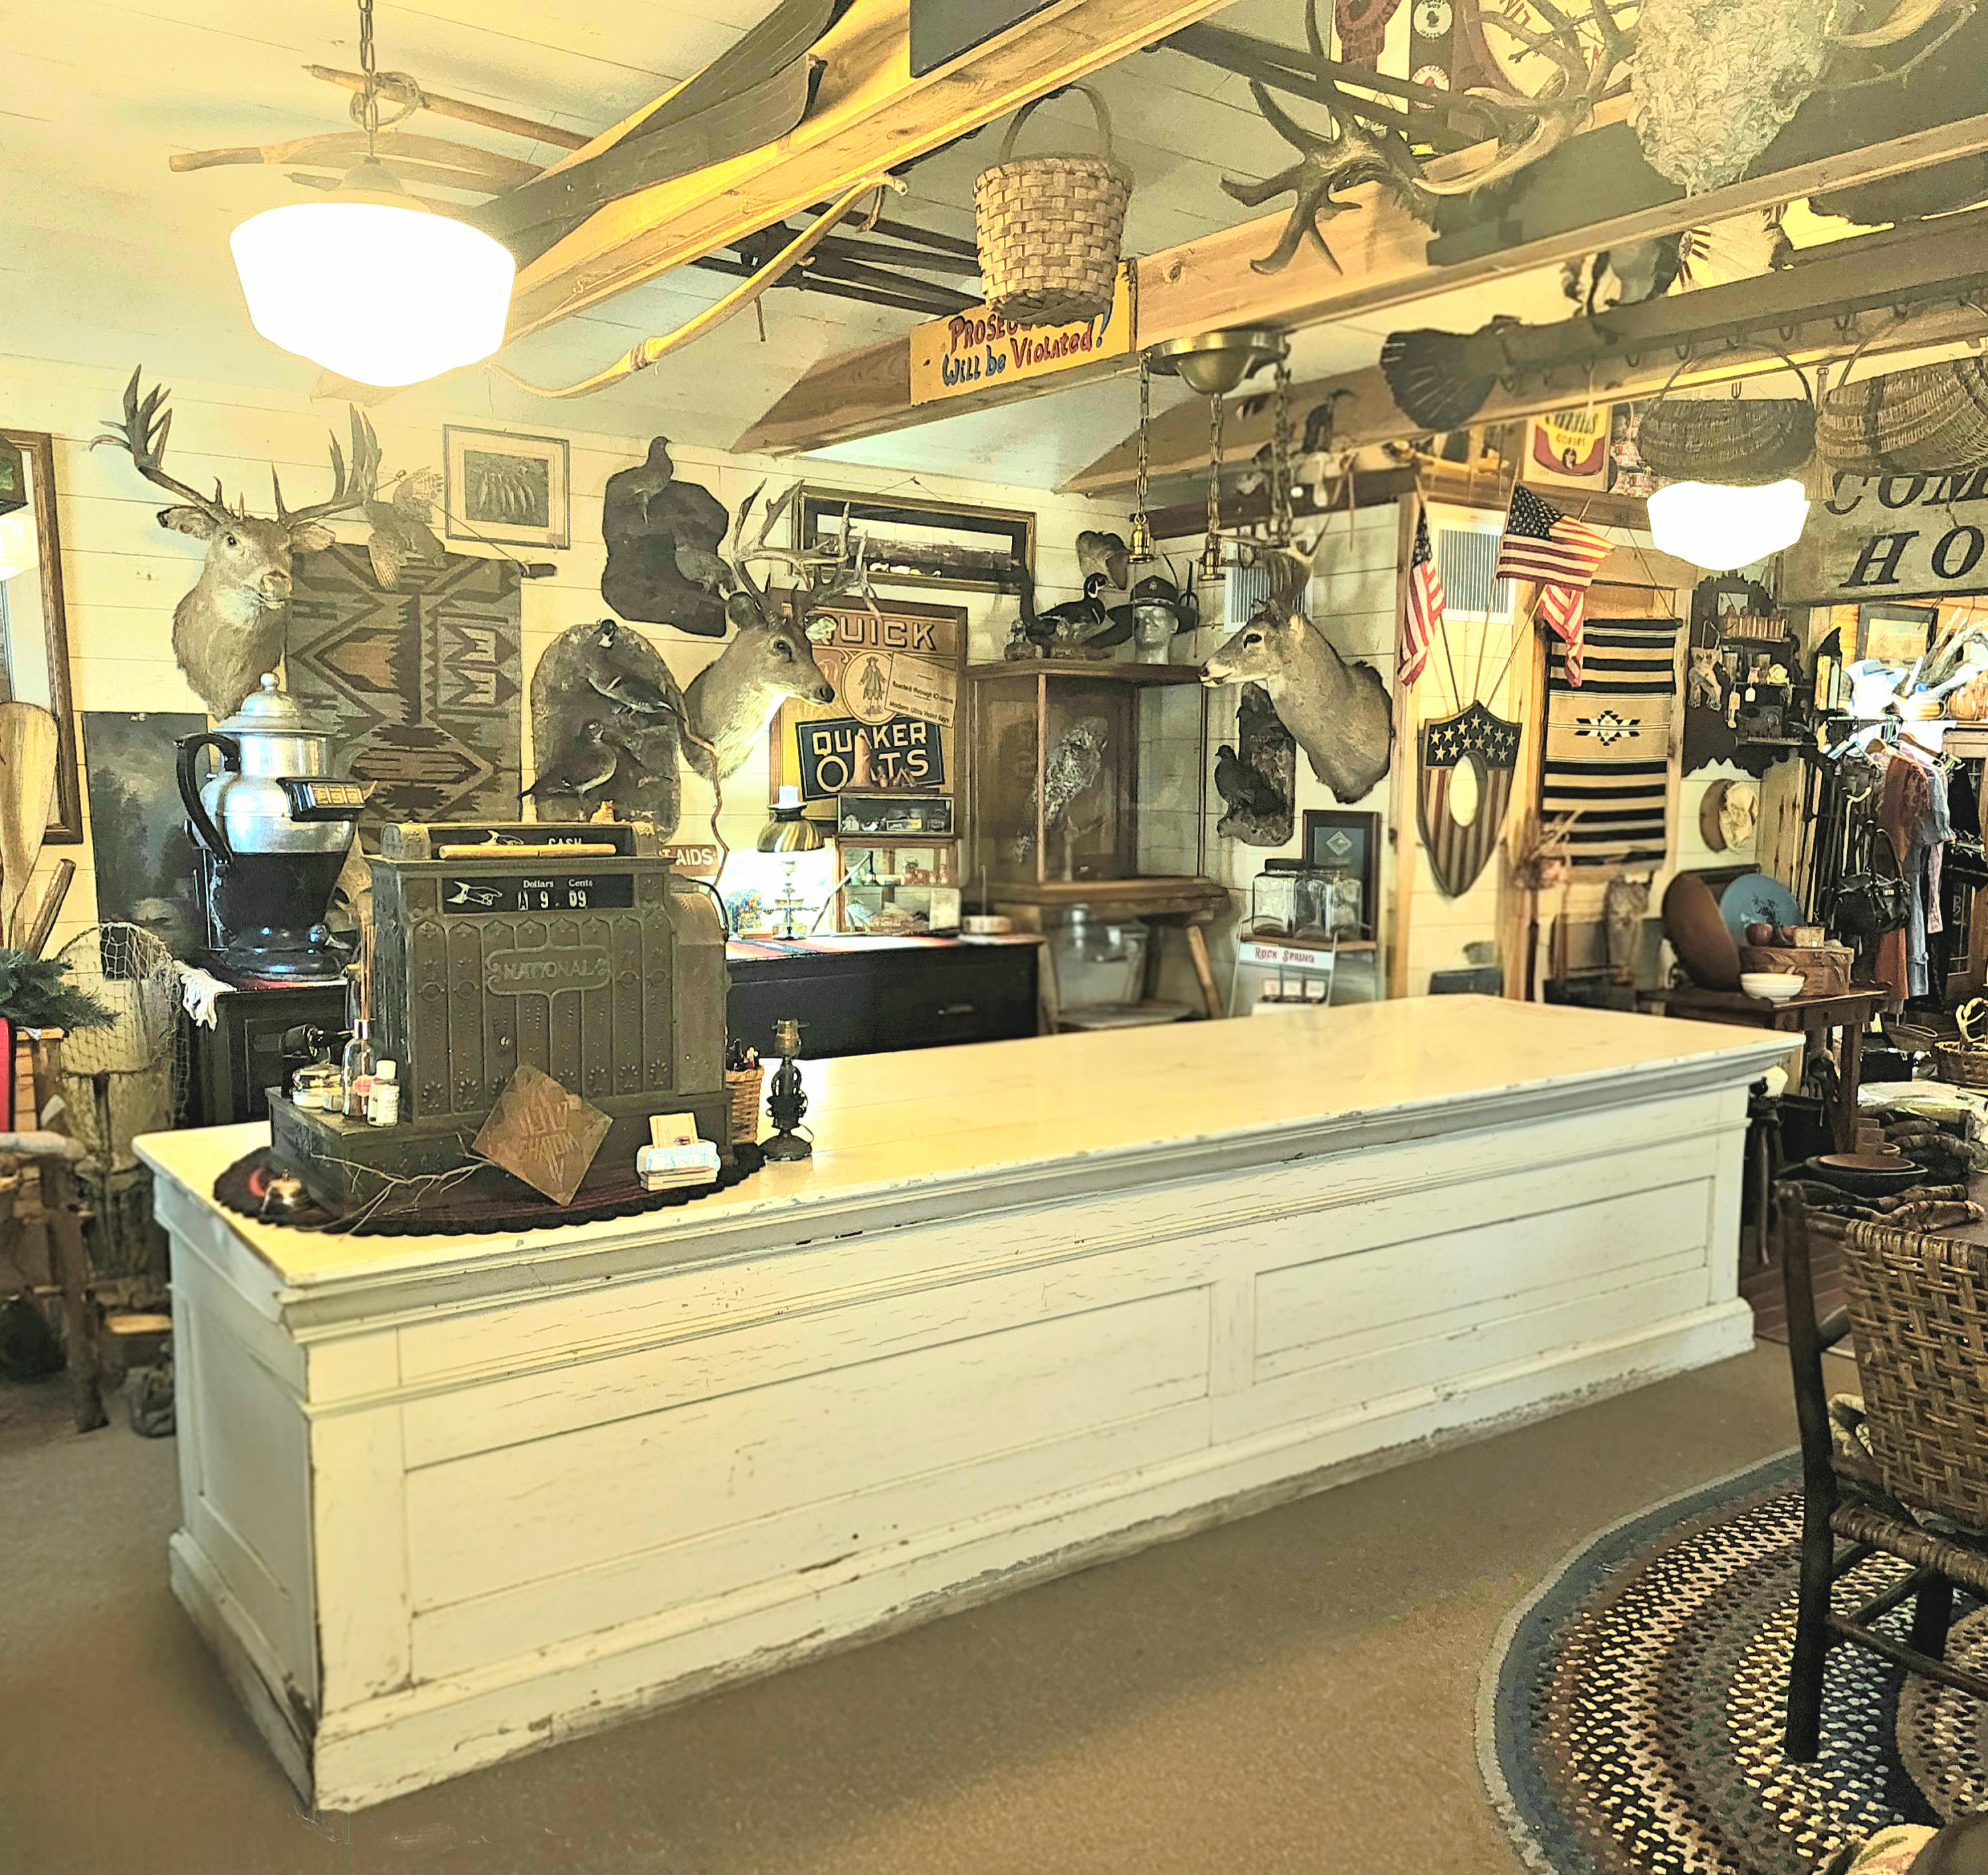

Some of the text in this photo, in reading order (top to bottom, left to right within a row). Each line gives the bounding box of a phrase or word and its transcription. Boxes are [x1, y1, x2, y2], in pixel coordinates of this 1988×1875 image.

[985, 344, 1006, 376] be
[816, 749, 930, 793] OTS
[675, 848, 714, 866] AIDS
[523, 878, 593, 888] Dollars Cents
[540, 890, 549, 909] 9
[502, 959, 595, 981] NATIONAL
